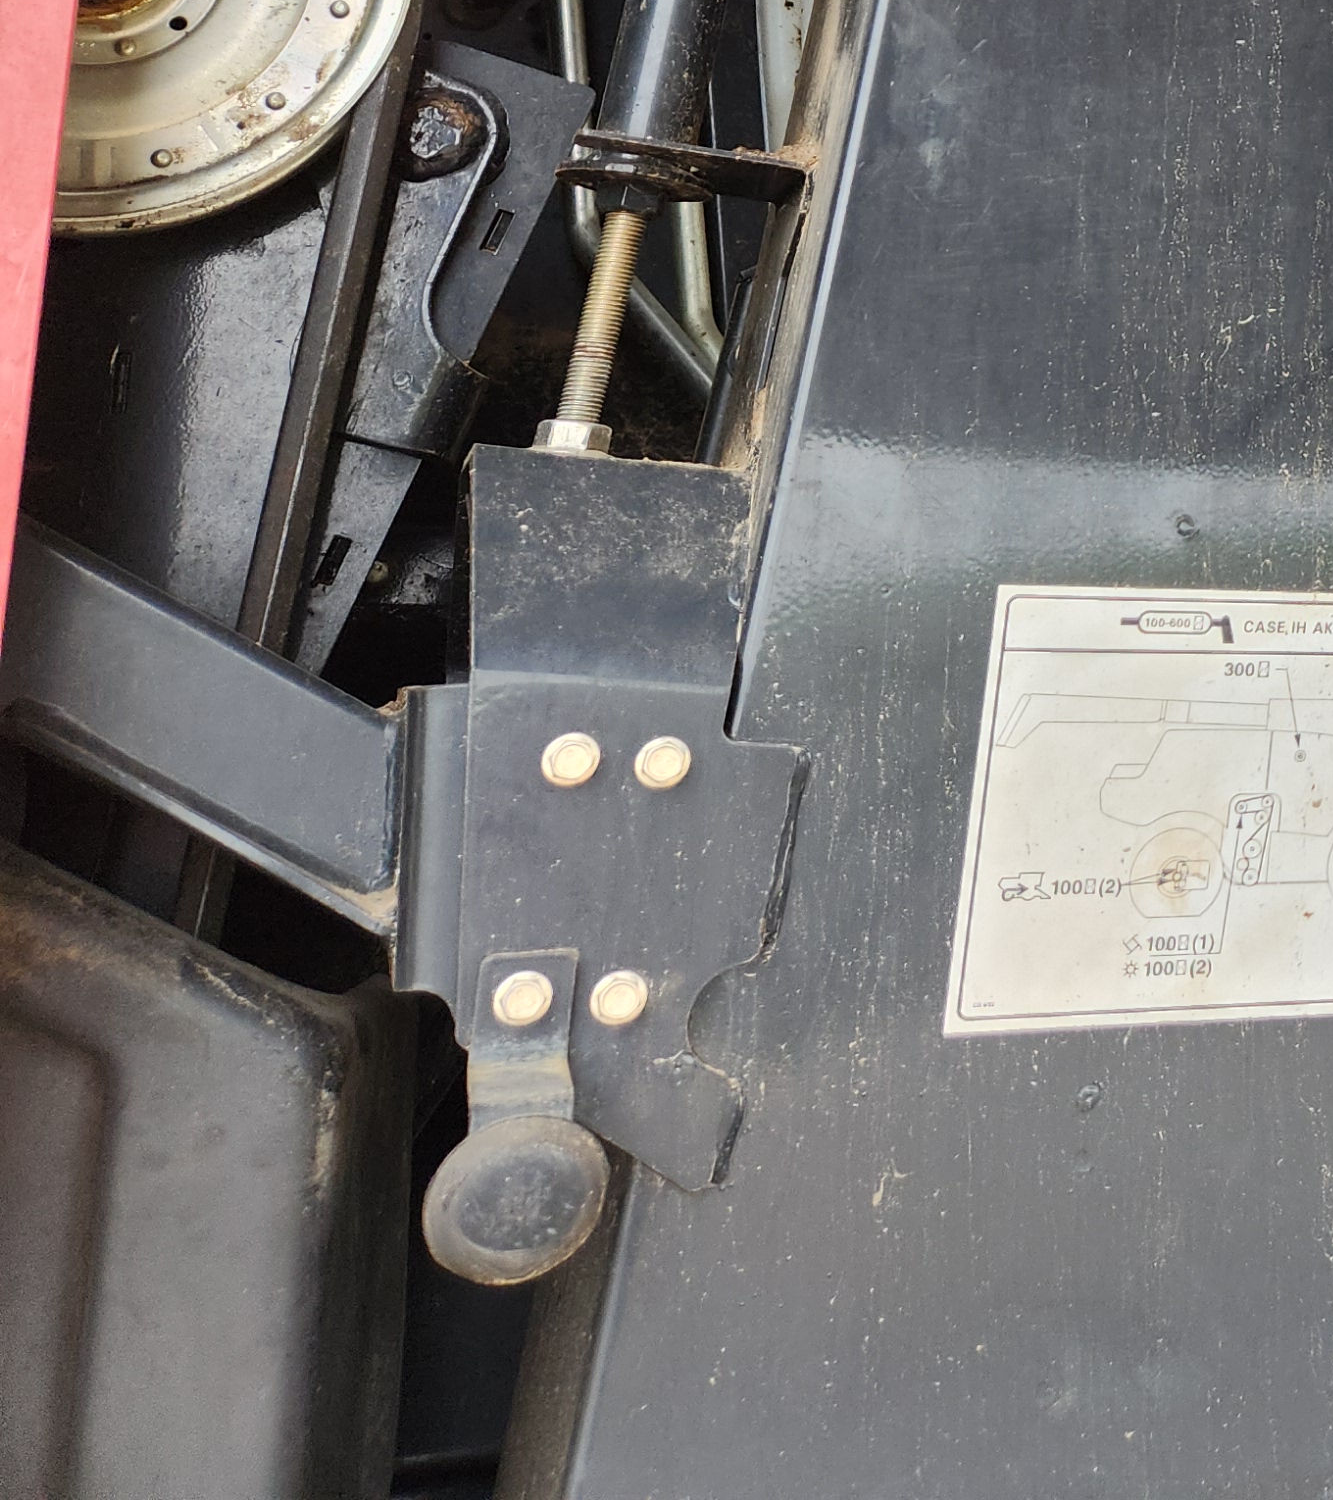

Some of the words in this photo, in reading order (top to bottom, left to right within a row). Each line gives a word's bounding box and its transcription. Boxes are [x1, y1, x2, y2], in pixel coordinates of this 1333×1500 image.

[1144, 617, 1191, 629] 100-600
[1291, 621, 1307, 634] IH
[1223, 662, 1256, 677] 300
[1051, 879, 1083, 896] 100
[1147, 935, 1177, 952] 100
[1143, 961, 1175, 977] 100
